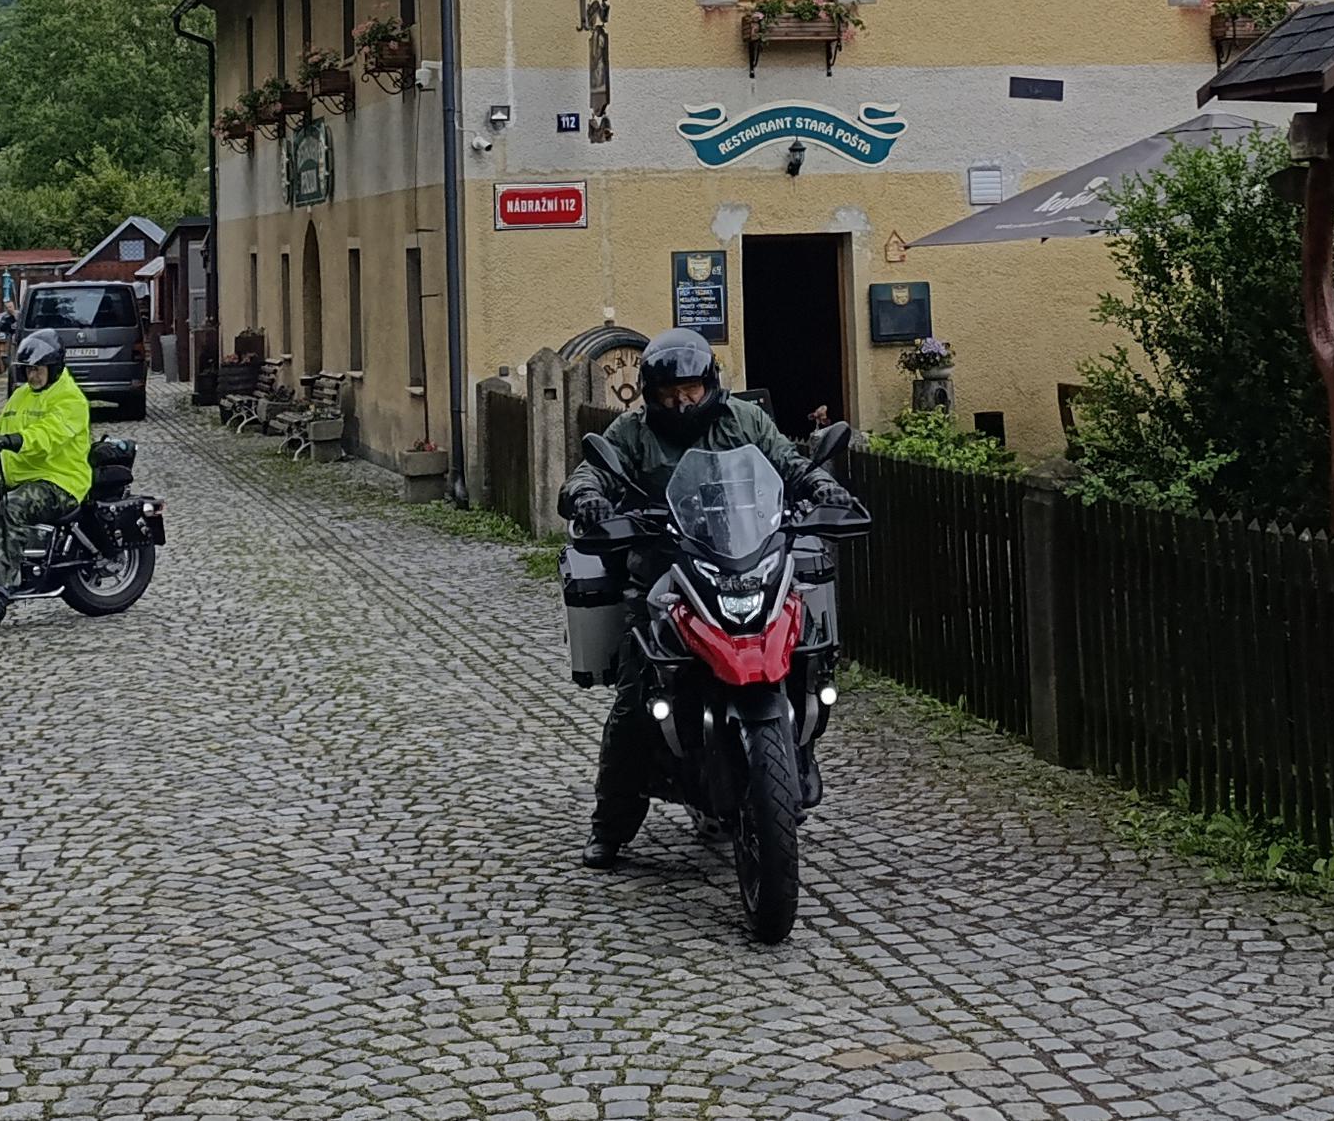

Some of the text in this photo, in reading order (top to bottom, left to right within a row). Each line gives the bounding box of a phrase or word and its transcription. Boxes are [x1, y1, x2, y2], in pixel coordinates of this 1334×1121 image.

[561, 116, 576, 128] 112
[718, 117, 871, 155] RESTAURANT STARÁ POŠTA
[506, 196, 576, 213] NÁDRAŽNÍ 112
